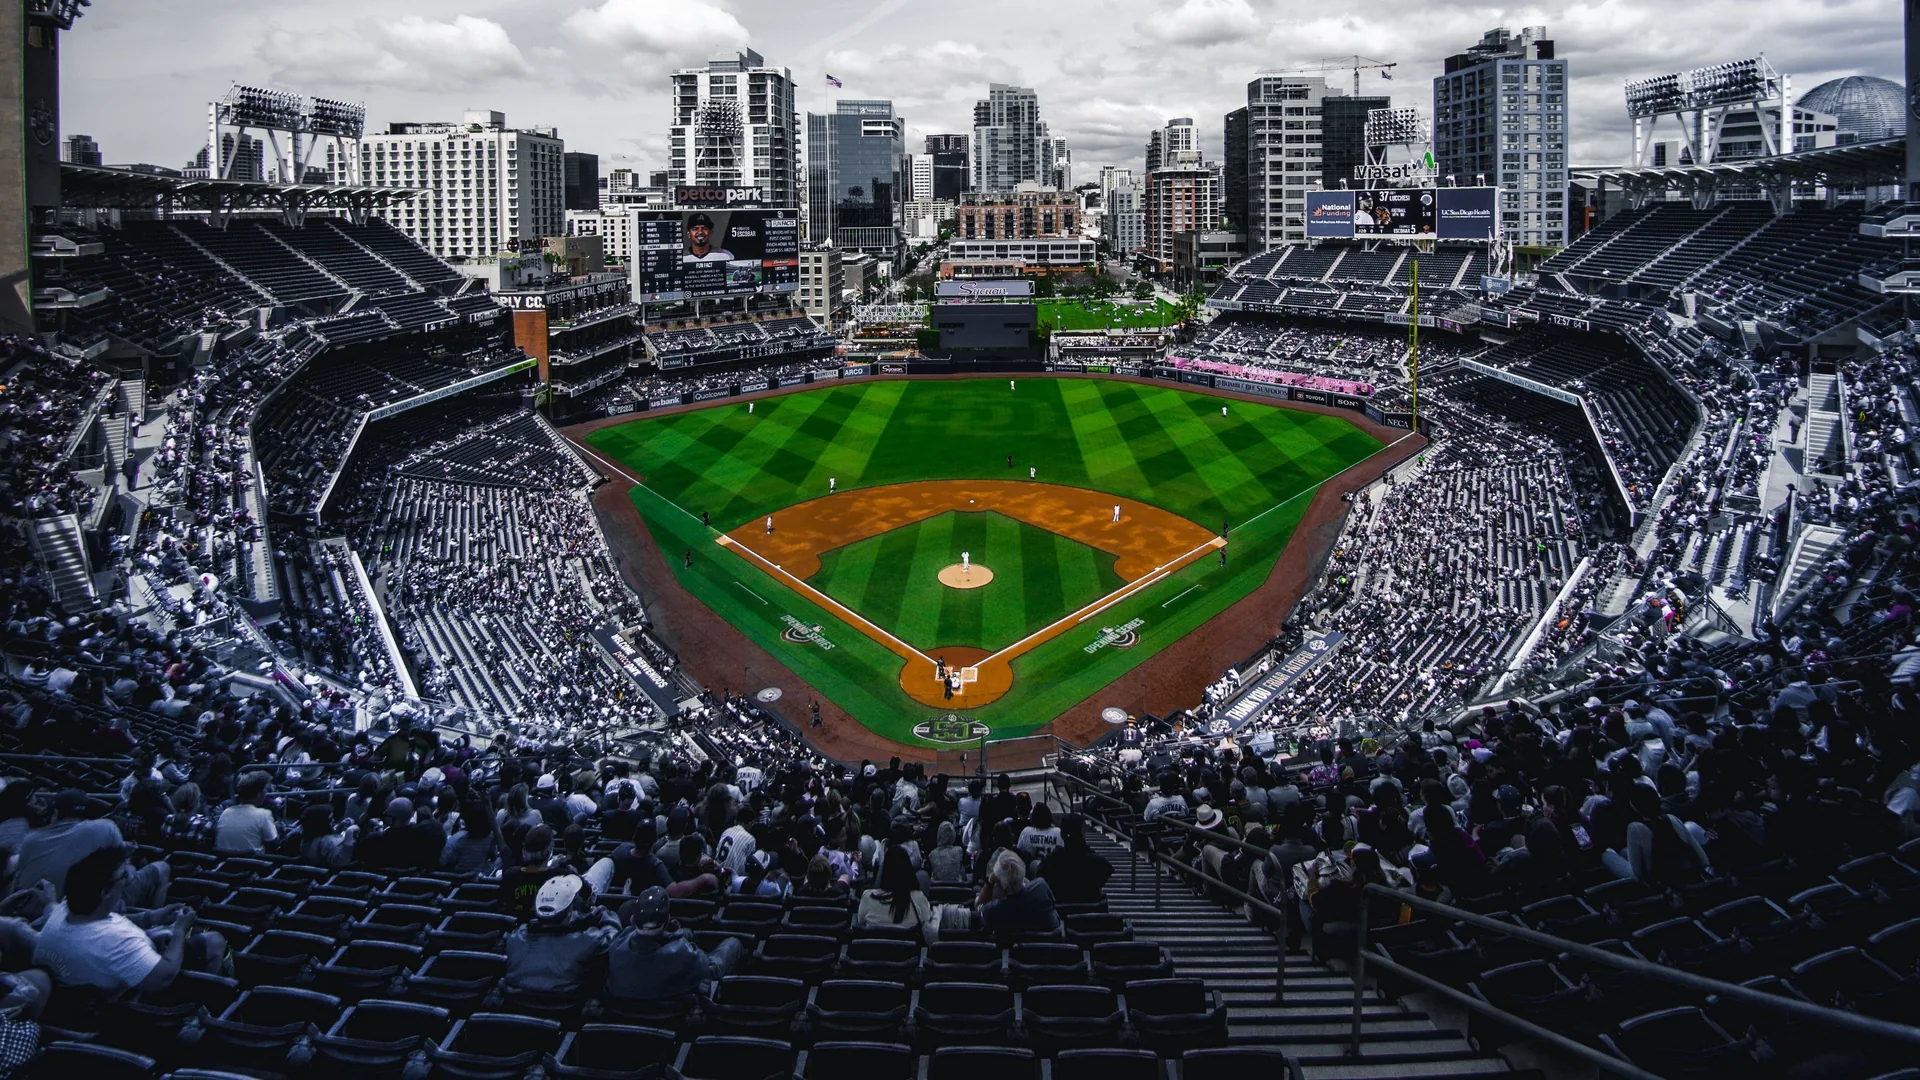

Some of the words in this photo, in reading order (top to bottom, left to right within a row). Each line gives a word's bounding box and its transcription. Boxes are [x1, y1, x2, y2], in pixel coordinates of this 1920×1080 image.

[1356, 164, 1411, 179] Viasat
[1380, 191, 1389, 202] 37
[732, 227, 737, 238] 5
[1411, 225, 1416, 233] 5
[546, 290, 575, 304] WESTERN
[578, 286, 596, 300] METAL
[597, 281, 619, 295] SUPPLY
[618, 279, 628, 290] CO.
[525, 296, 545, 308] CO.
[851, 304, 929, 317] NATIONAL
[815, 370, 837, 378] BUDWEISER
[844, 368, 863, 376] ARCO
[742, 383, 768, 392] GEICO
[1221, 380, 1244, 390] BUMBLE
[1257, 385, 1288, 396] SEAFOODS
[1305, 394, 1325, 402] TOYOTA
[1387, 418, 1409, 428] NECA
[1115, 617, 1145, 635] SERIES
[806, 632, 836, 650] SERIES
[1083, 632, 1121, 654] OPENING
[1225, 694, 1260, 721] THANK
[1262, 670, 1291, 691] FRIAR
[1281, 650, 1318, 675] FAITHFUL
[1030, 834, 1057, 845] HOFFMAN
[717, 836, 734, 862] 6
